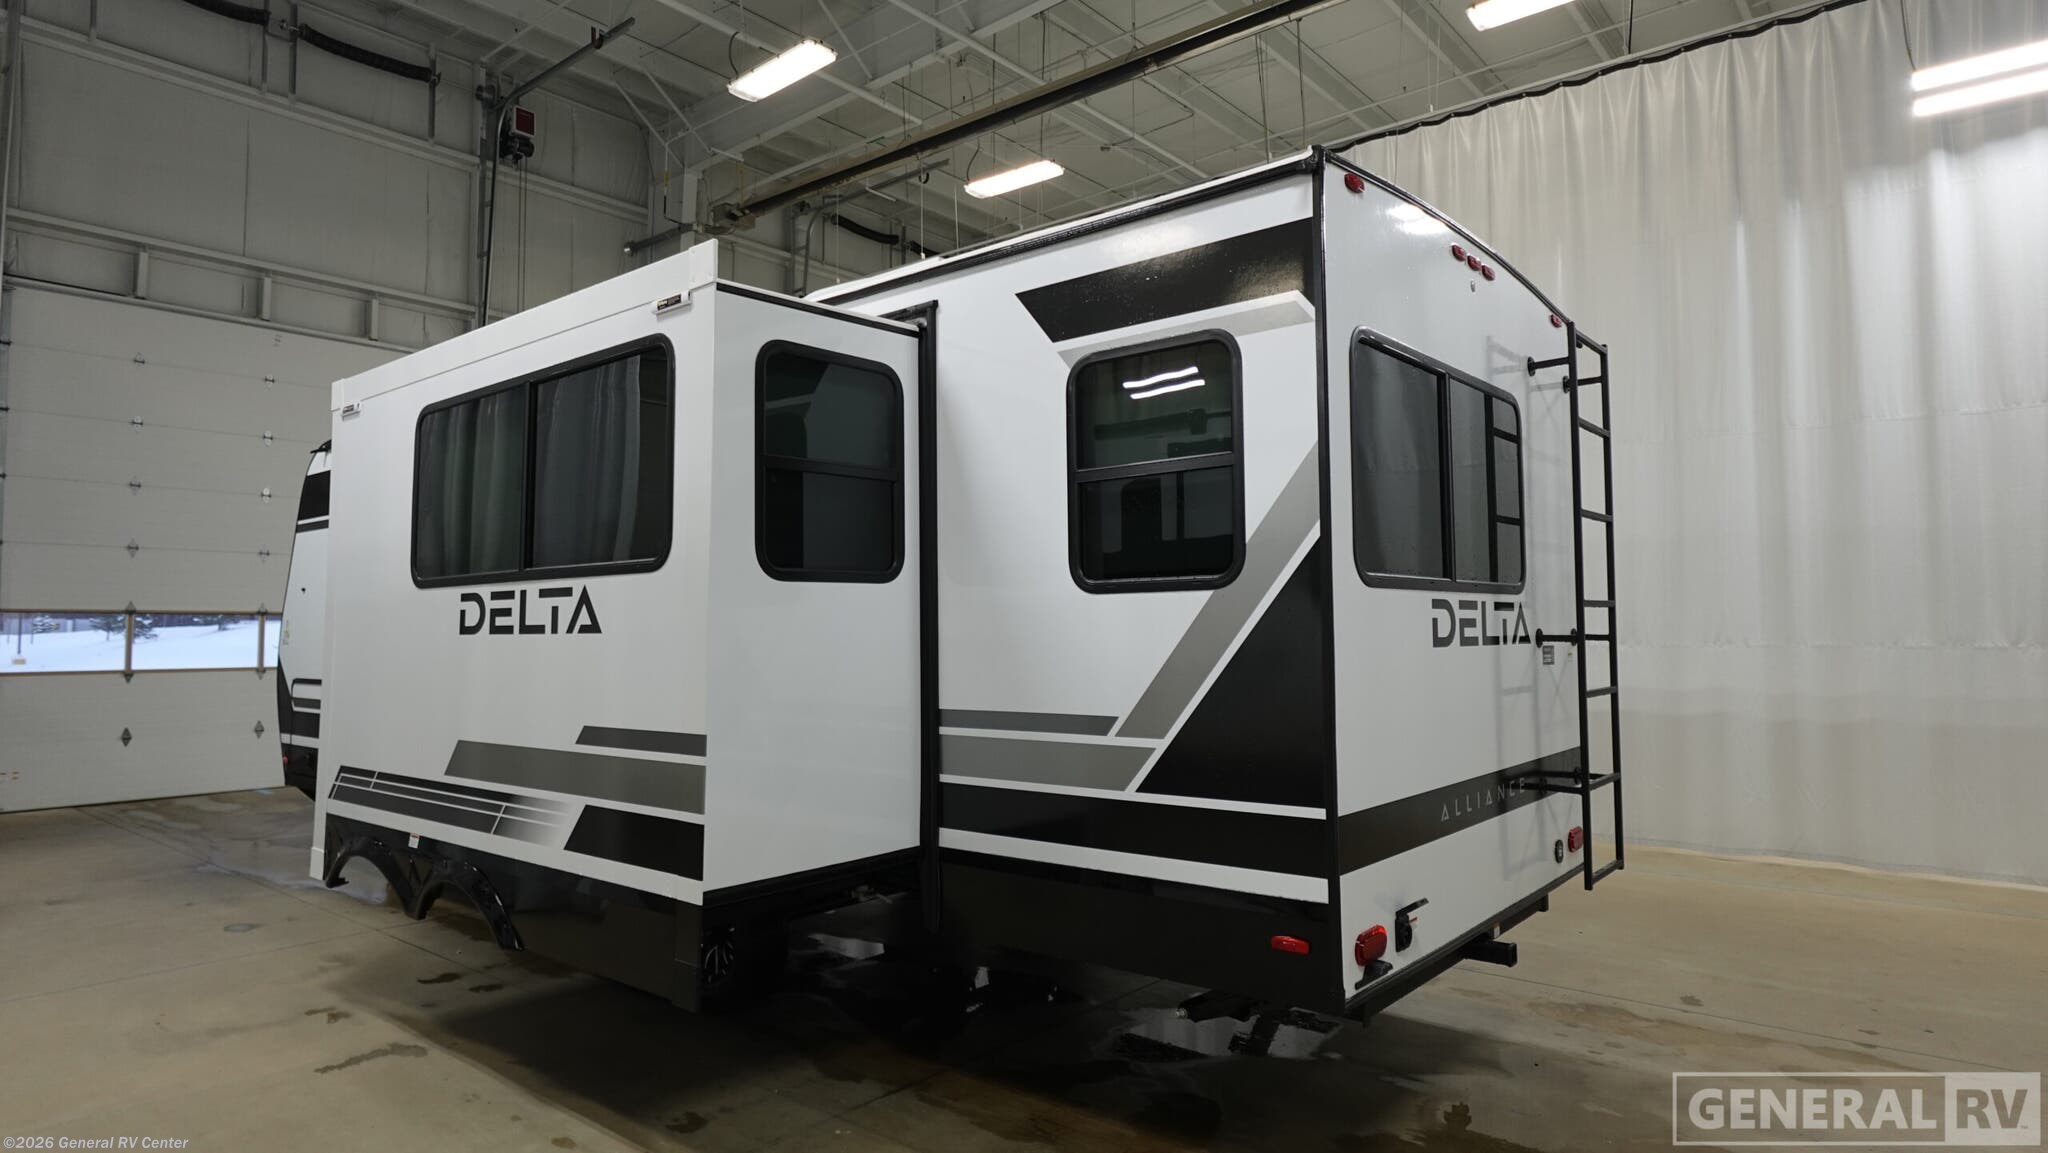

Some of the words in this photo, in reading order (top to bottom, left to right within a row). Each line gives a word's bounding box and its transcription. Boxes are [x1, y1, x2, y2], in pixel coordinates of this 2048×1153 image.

[459, 584, 602, 635] DELTA
[1431, 598, 1531, 648] DELTA
[1441, 777, 1525, 822] ALLIANCE
